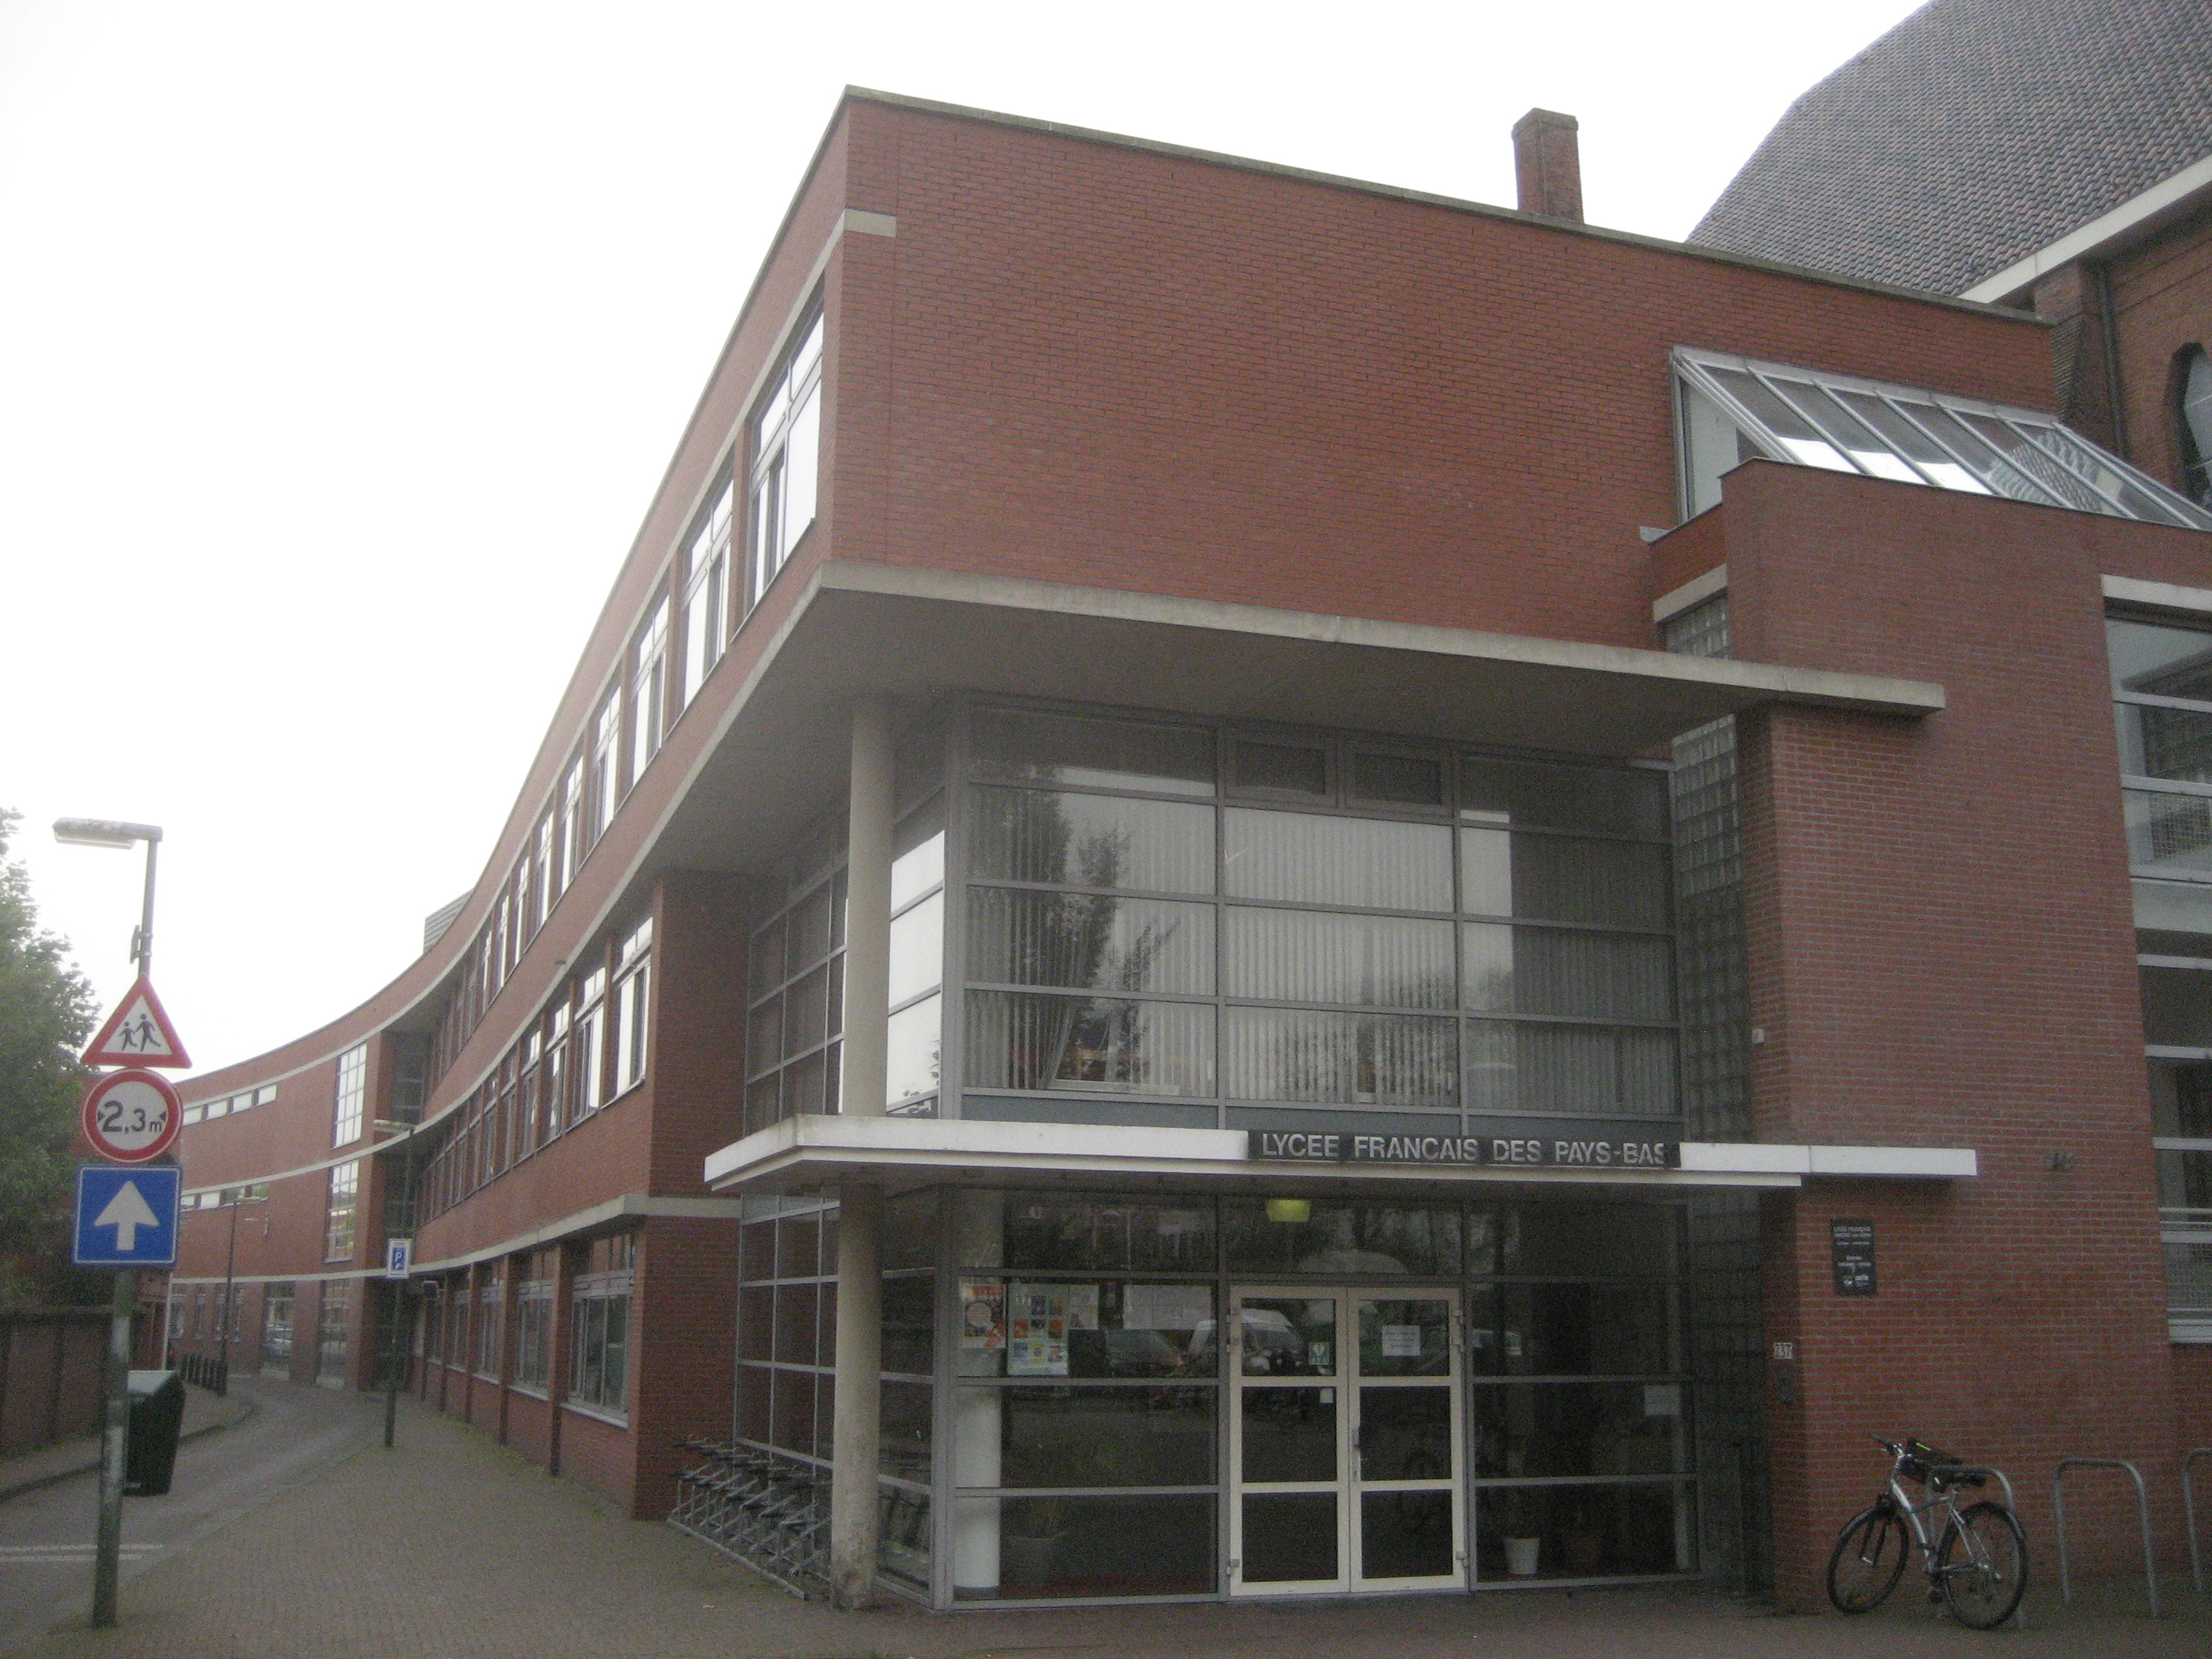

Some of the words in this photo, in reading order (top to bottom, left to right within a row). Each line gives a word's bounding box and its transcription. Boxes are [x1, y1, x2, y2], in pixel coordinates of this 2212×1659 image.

[1262, 1133, 1339, 1157] LYCEE
[1354, 1136, 1479, 1161] FRANCAIS
[1493, 1139, 1541, 1163] DES
[1555, 1141, 1665, 1165] PAYS-BAS
[394, 1251, 402, 1262] P
